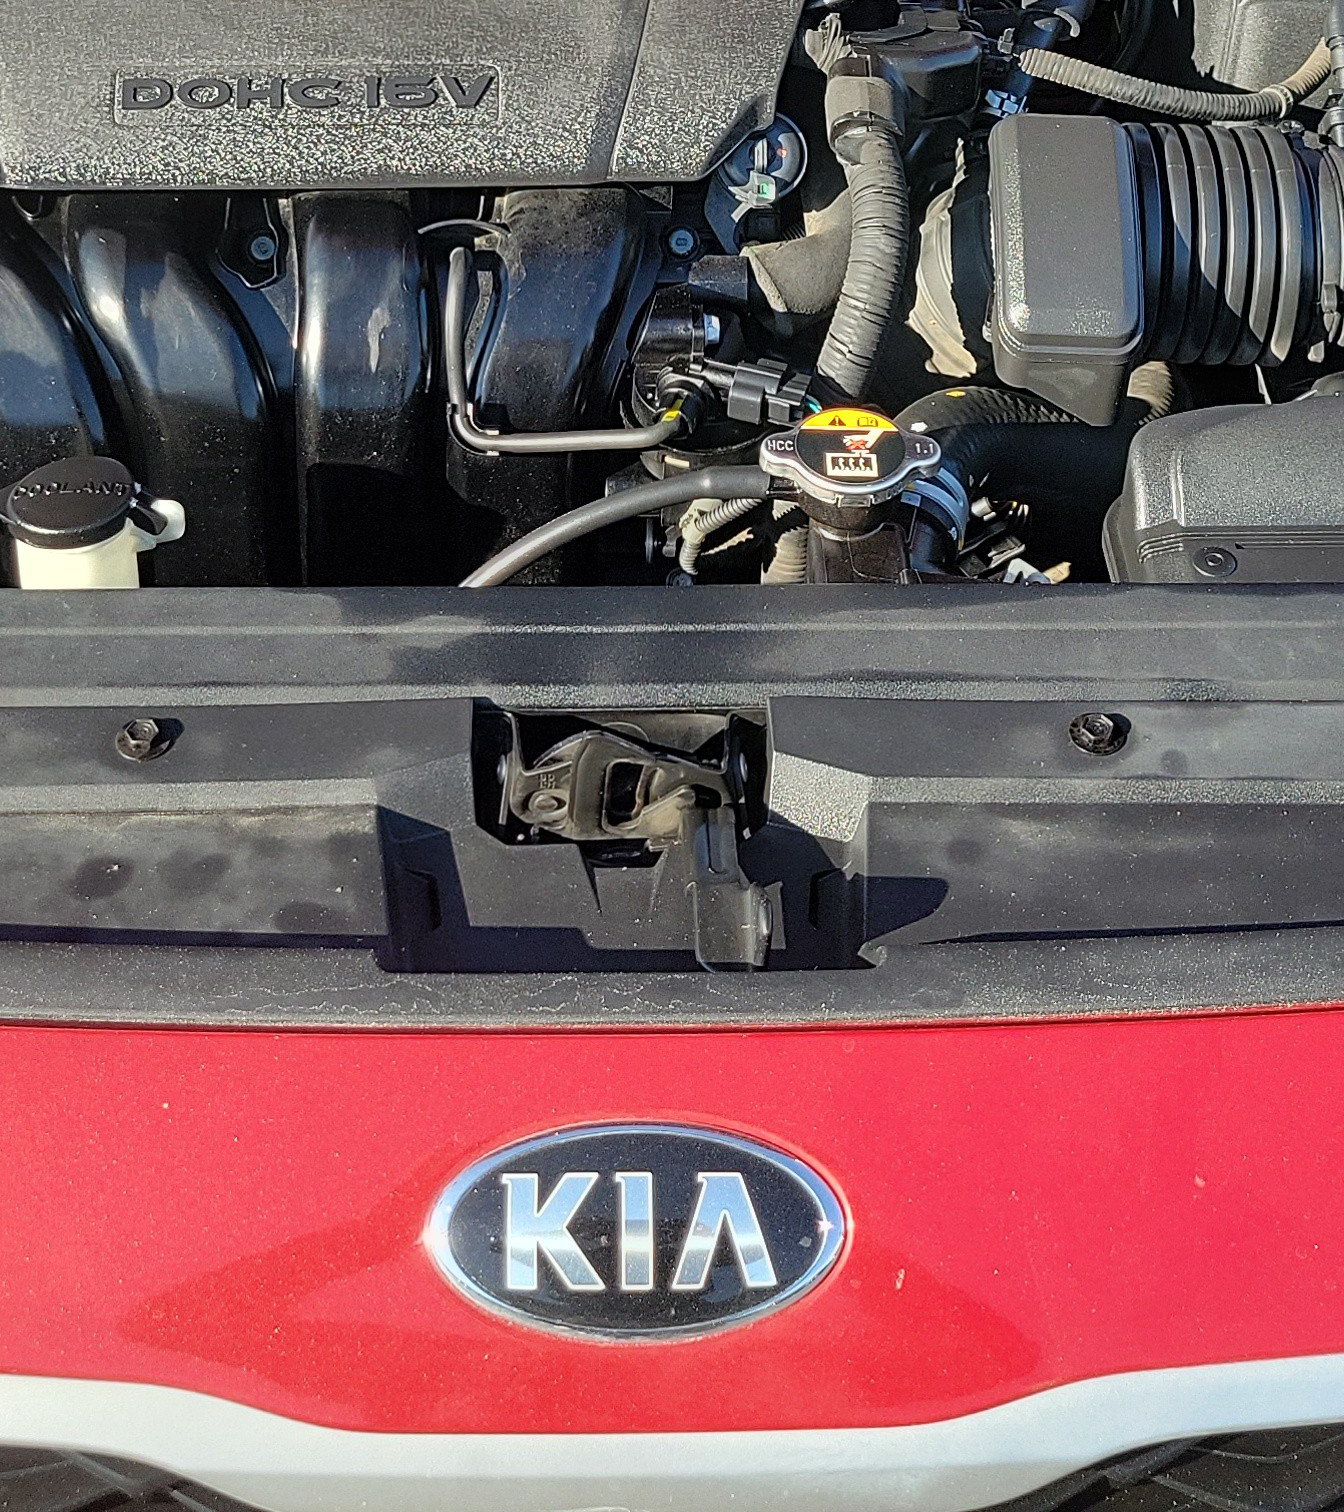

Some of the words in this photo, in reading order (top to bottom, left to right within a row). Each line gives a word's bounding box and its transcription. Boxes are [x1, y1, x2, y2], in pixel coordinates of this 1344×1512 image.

[121, 76, 343, 110] DOHC
[367, 75, 496, 109] 16V
[767, 439, 794, 451] HCC
[915, 442, 934, 454] 1.1
[13, 480, 131, 500] COOLANT
[502, 1171, 778, 1292] KIA
